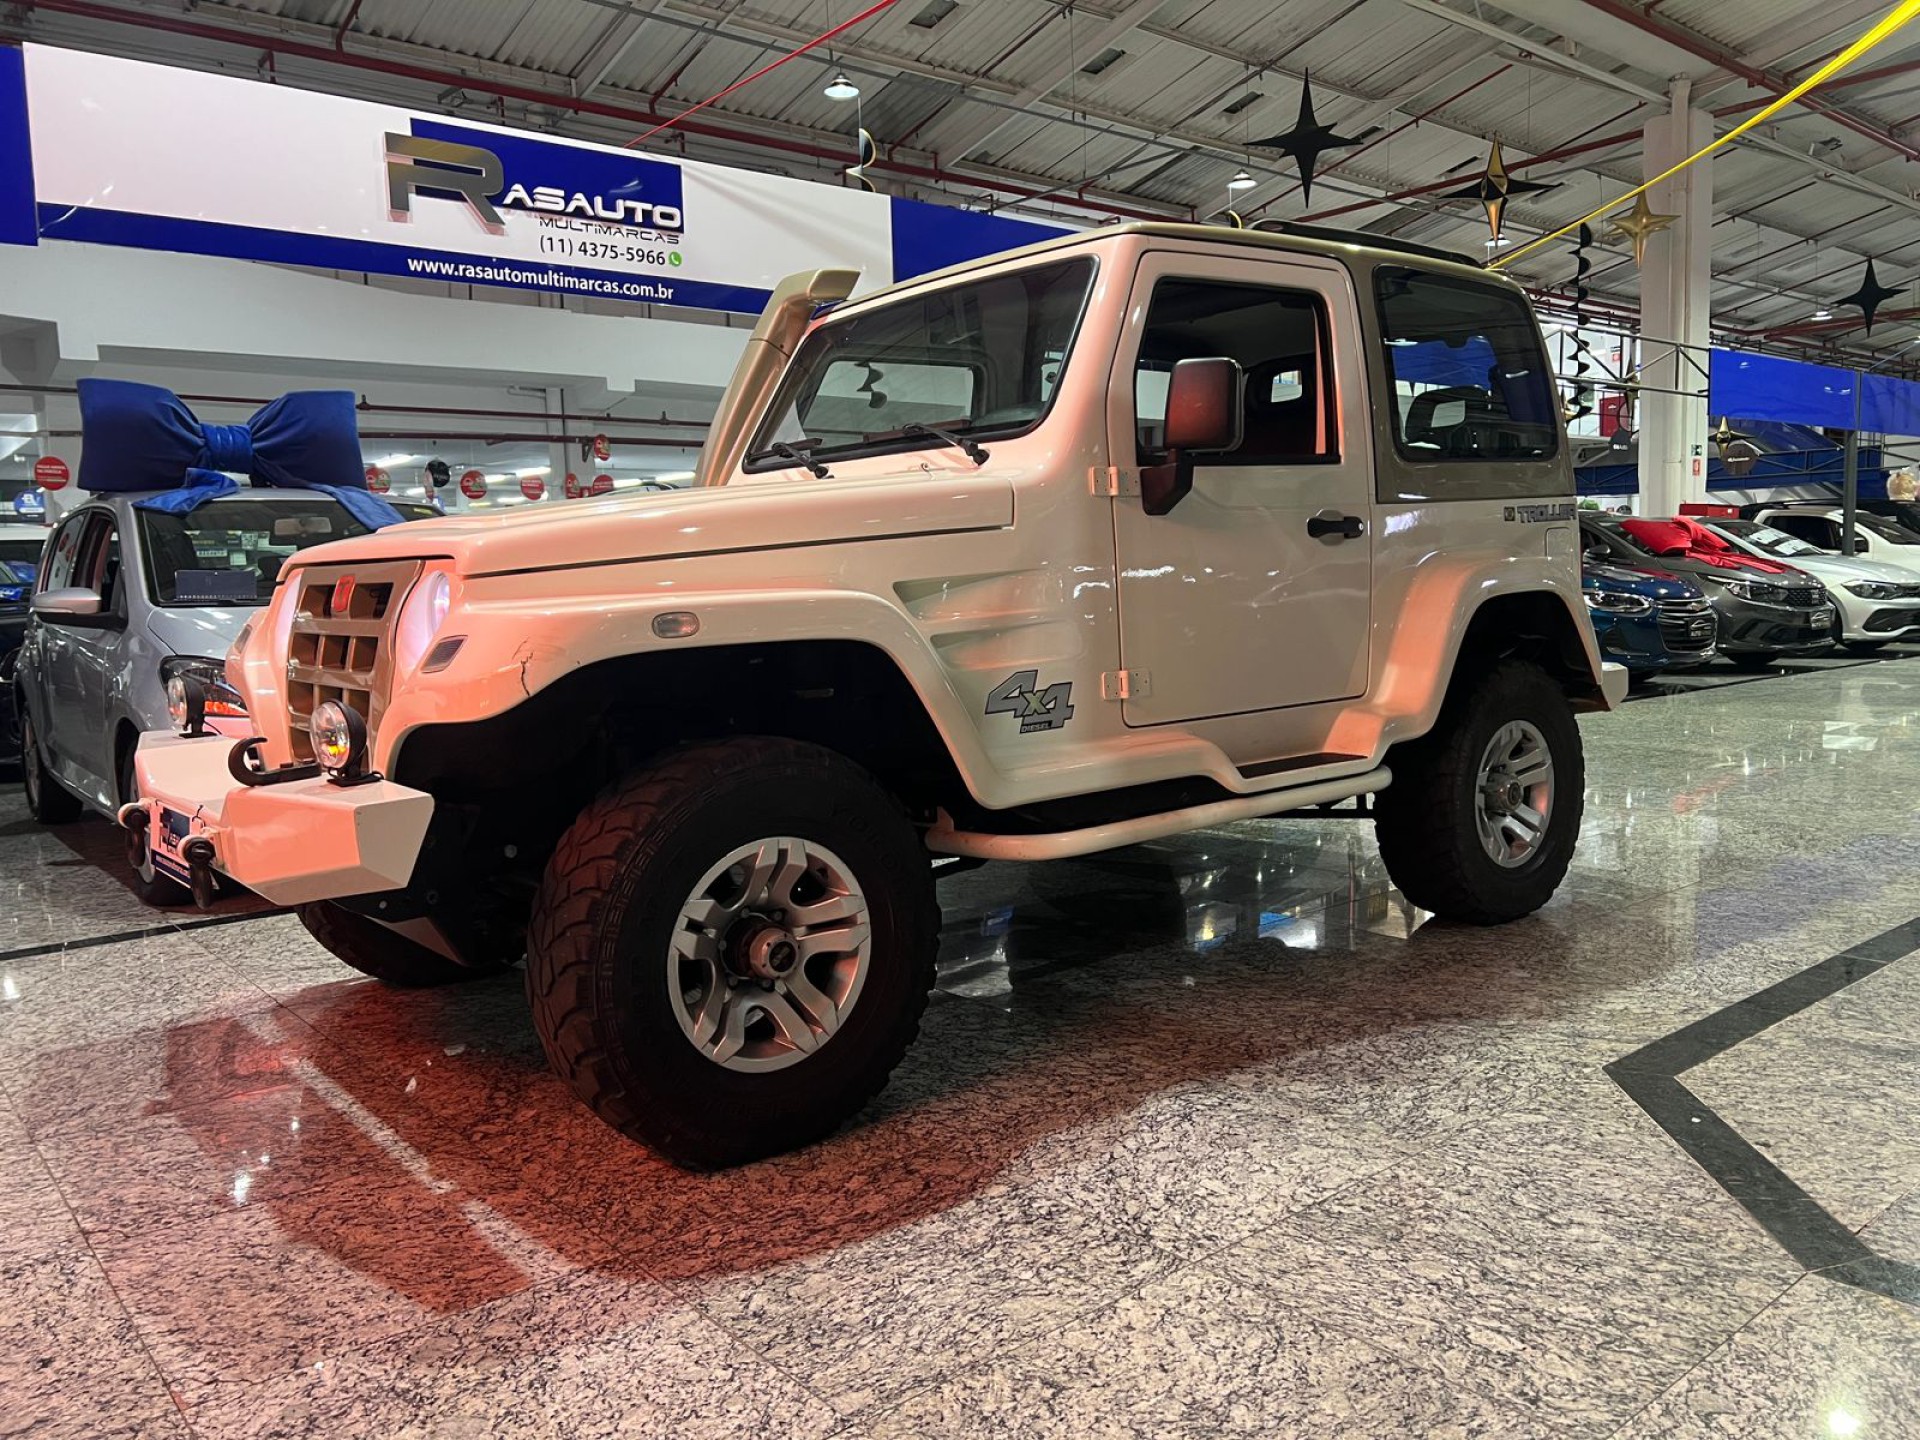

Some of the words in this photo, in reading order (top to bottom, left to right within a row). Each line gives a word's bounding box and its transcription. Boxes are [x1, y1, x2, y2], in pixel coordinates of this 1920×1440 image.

[540, 235, 574, 257] (11)
[578, 241, 666, 266] 4375-5966
[408, 258, 674, 299] www.rasautomultimarcas.com.br
[1021, 722, 1051, 733] DIESEL
